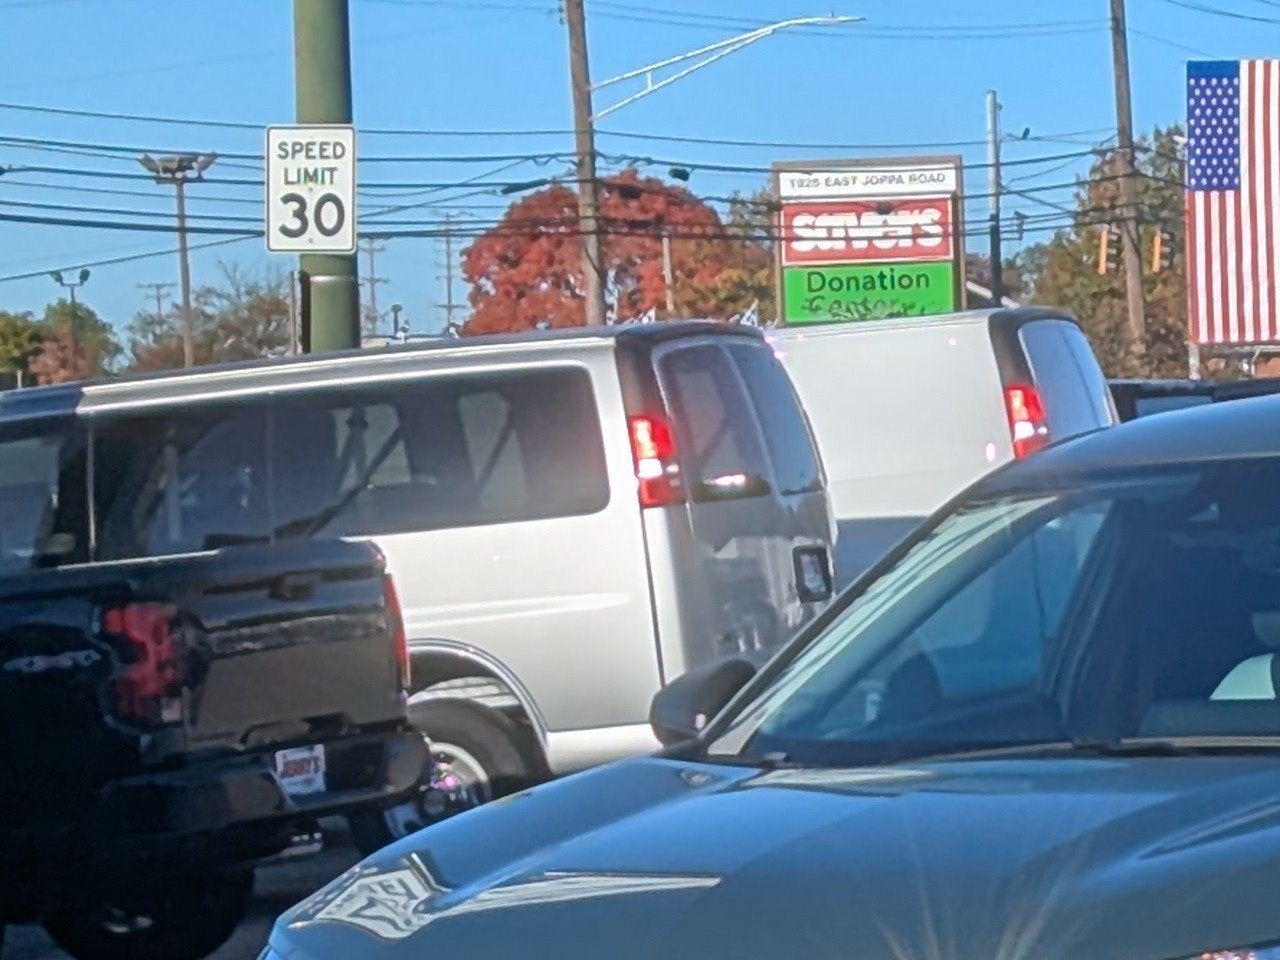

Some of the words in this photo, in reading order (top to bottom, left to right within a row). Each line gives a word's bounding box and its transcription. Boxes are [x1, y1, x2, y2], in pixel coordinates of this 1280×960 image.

[277, 140, 346, 159] SPEED
[283, 167, 338, 185] LIMIT
[825, 177, 857, 186] EAST
[862, 175, 904, 186] JOPPA
[909, 173, 946, 184] ROAD
[279, 192, 345, 238] 30
[807, 268, 930, 292] Donation
